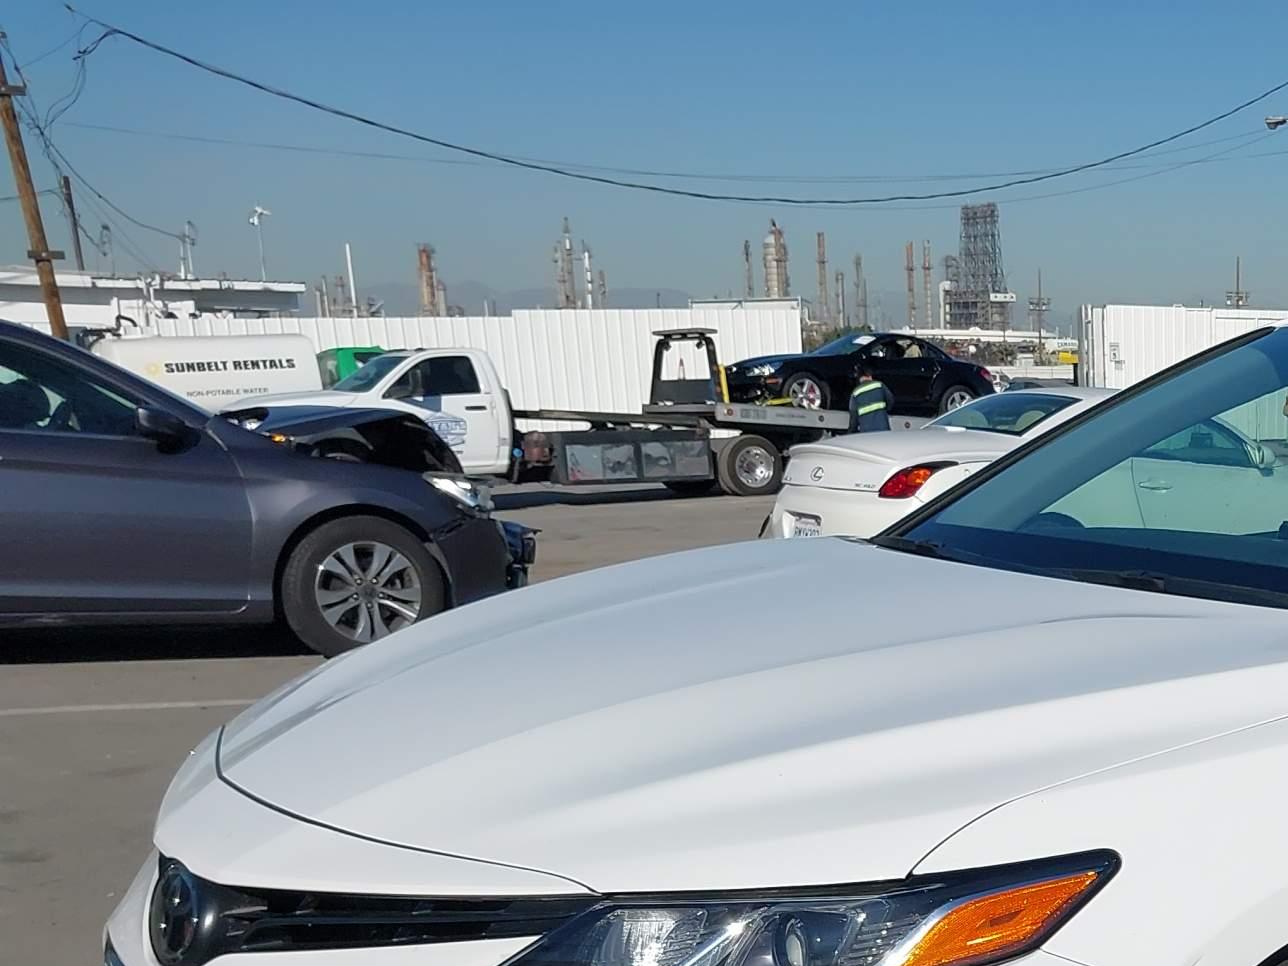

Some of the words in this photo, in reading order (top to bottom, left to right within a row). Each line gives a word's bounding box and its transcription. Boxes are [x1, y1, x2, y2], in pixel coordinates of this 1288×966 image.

[164, 361, 228, 373] SUNBELT
[232, 358, 296, 371] RENTALS
[187, 387, 242, 397] NON-POTABLE
[243, 387, 269, 395] WATER
